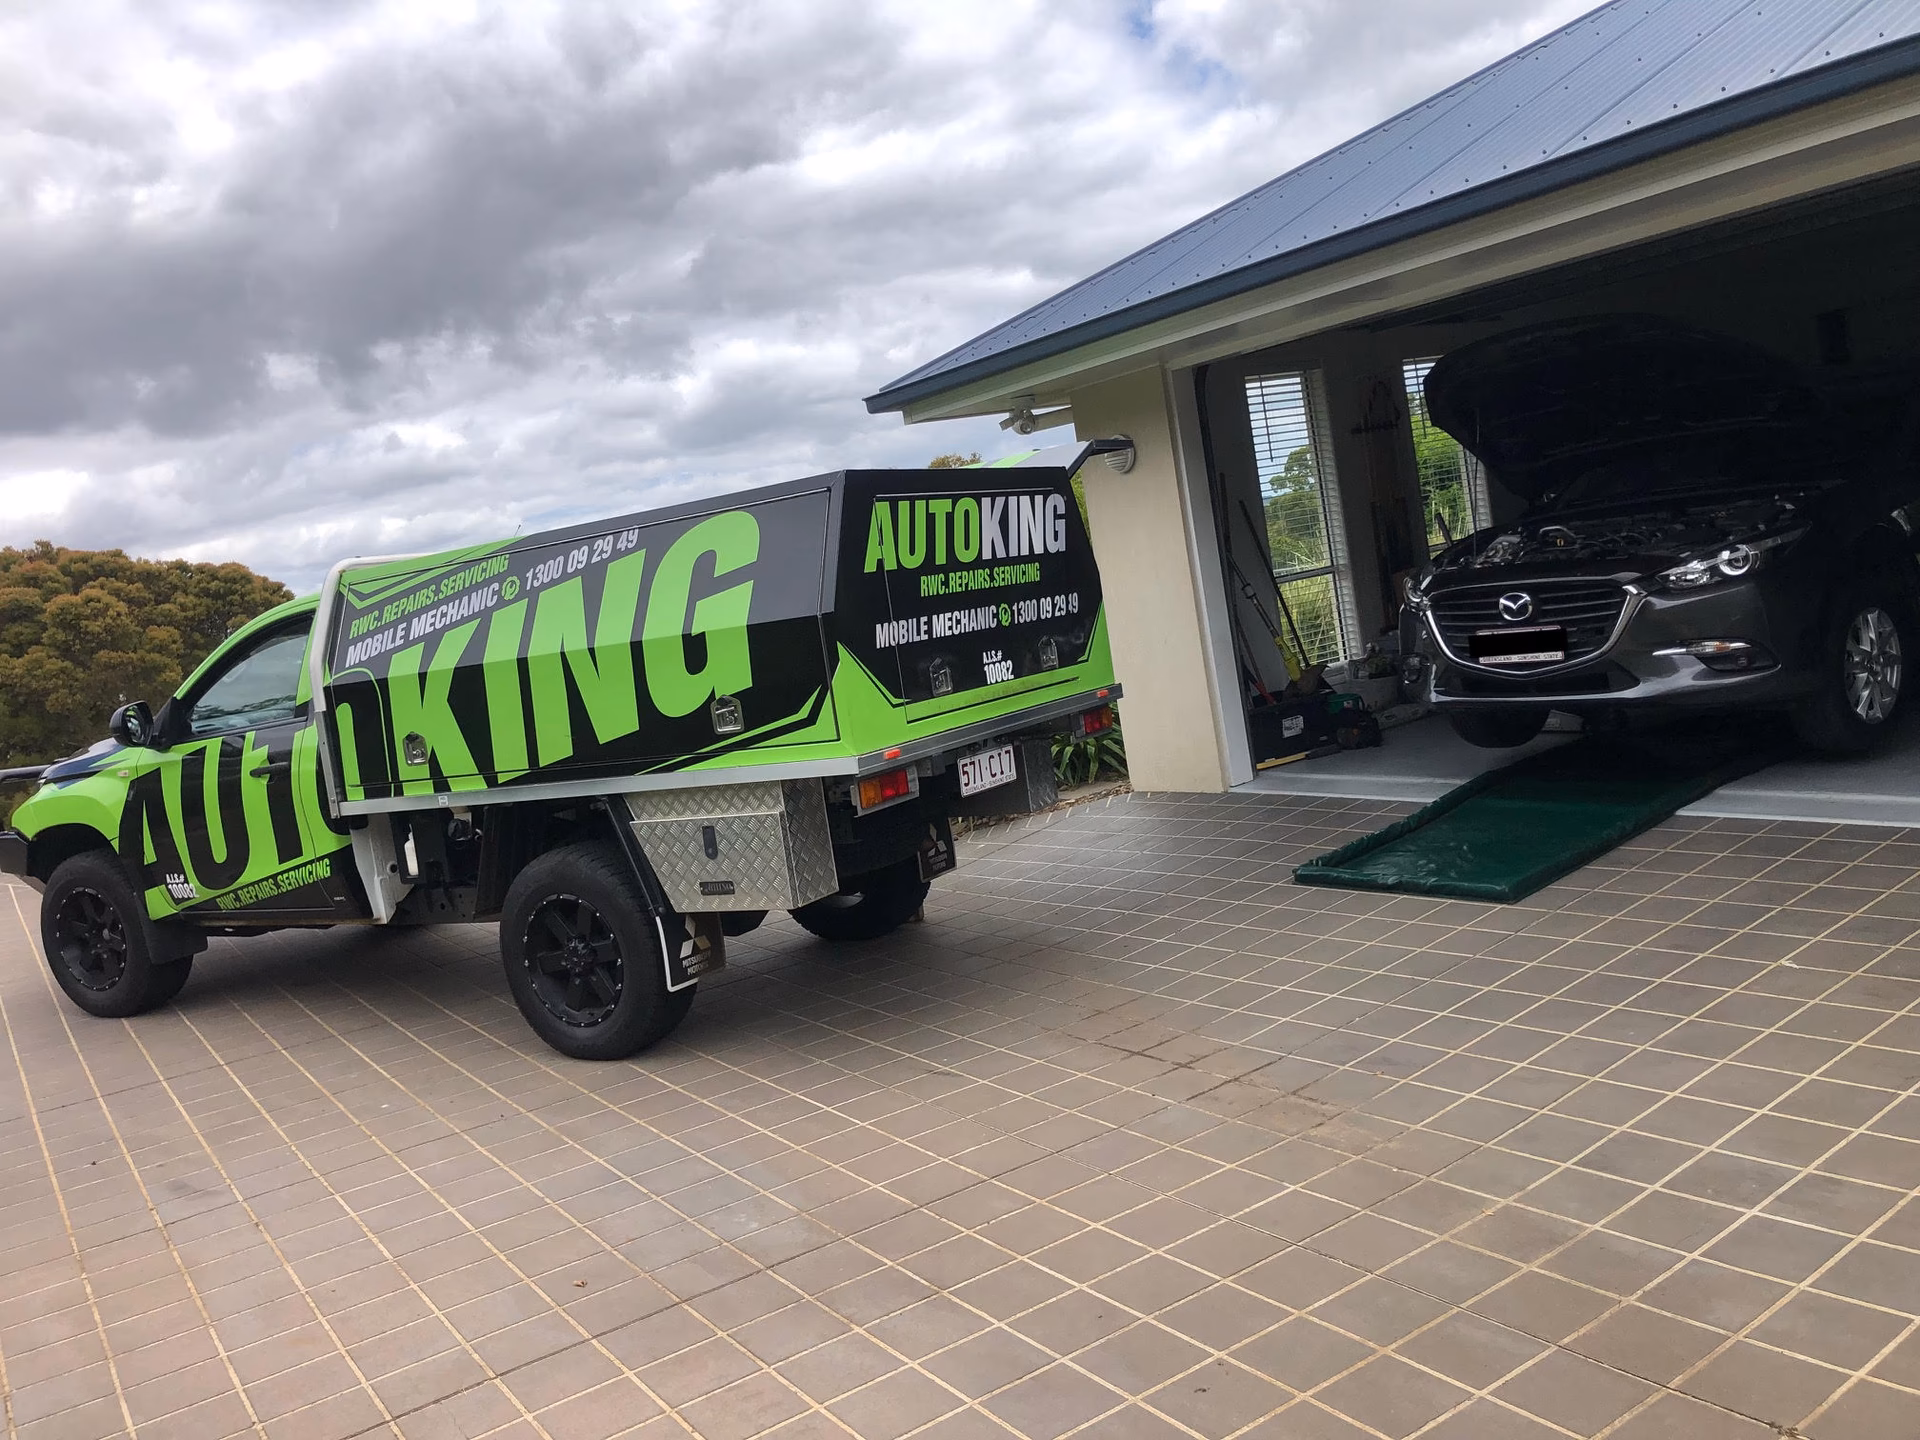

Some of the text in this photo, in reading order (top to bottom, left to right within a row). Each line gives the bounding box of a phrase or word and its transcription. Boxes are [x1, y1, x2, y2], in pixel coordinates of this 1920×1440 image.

[525, 527, 639, 591] 1300 09 29 49
[345, 583, 499, 668] MOBILE MECHANIC
[875, 605, 998, 649] MOBILE MECHANIC
[1012, 599, 1038, 625] 1300
[1039, 596, 1053, 620] 09
[1054, 594, 1067, 617] 29
[983, 660, 1015, 685] 10082
[168, 883, 199, 900] 10082
